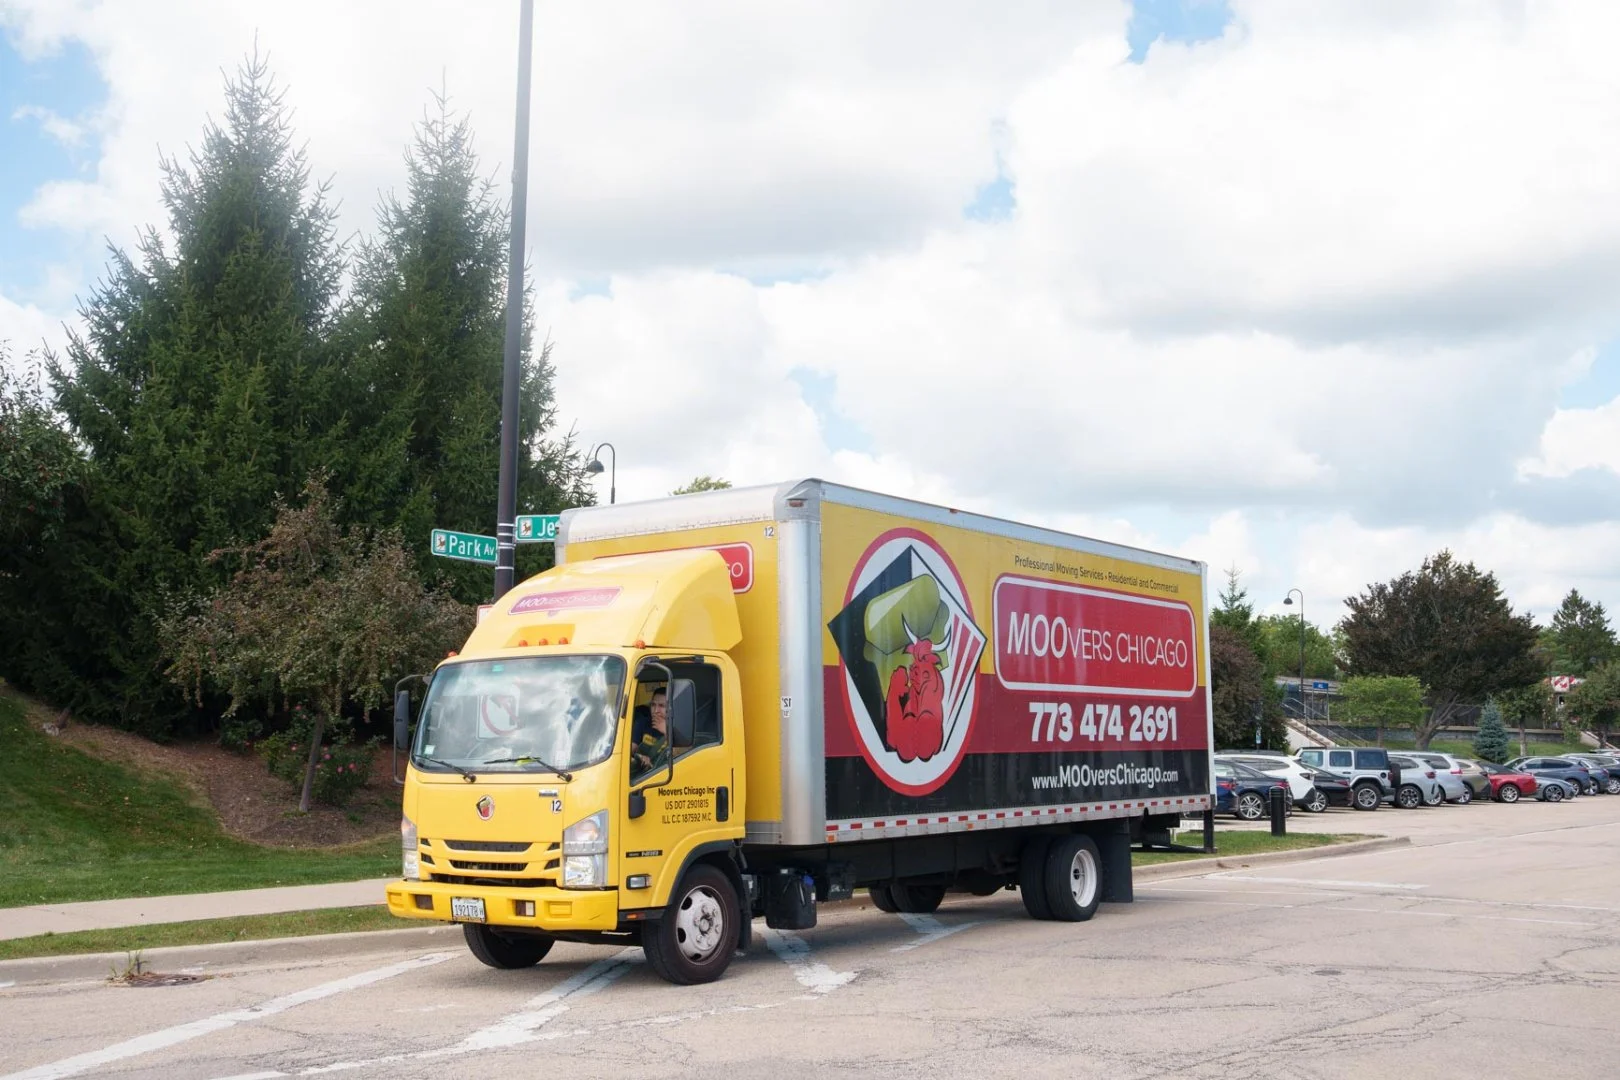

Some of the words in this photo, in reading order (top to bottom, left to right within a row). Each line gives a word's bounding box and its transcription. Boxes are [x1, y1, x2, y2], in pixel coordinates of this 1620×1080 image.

[537, 518, 556, 537] Je
[764, 526, 774, 537] 12
[449, 535, 481, 557] Park
[1014, 555, 1056, 573] Professional
[1056, 563, 1079, 579] Moving
[1079, 566, 1104, 580] Services
[1107, 571, 1138, 587] Residential
[1139, 578, 1149, 589] and
[1150, 579, 1179, 594] Commercial
[1007, 611, 1113, 662] MOOVERS
[1116, 633, 1188, 668] CHICAGO
[1028, 702, 1074, 743] 773
[1079, 703, 1124, 742] 474
[1129, 704, 1178, 742] 2691
[1031, 763, 1179, 789] www.MOOversChicago.com
[658, 787, 683, 797] Moovers
[683, 786, 706, 798] Chicago
[706, 786, 715, 795] Inc
[552, 799, 562, 812] 12
[664, 800, 674, 810] US
[674, 800, 686, 810] DOT
[687, 799, 709, 809] 2901815
[661, 814, 671, 824] ILL
